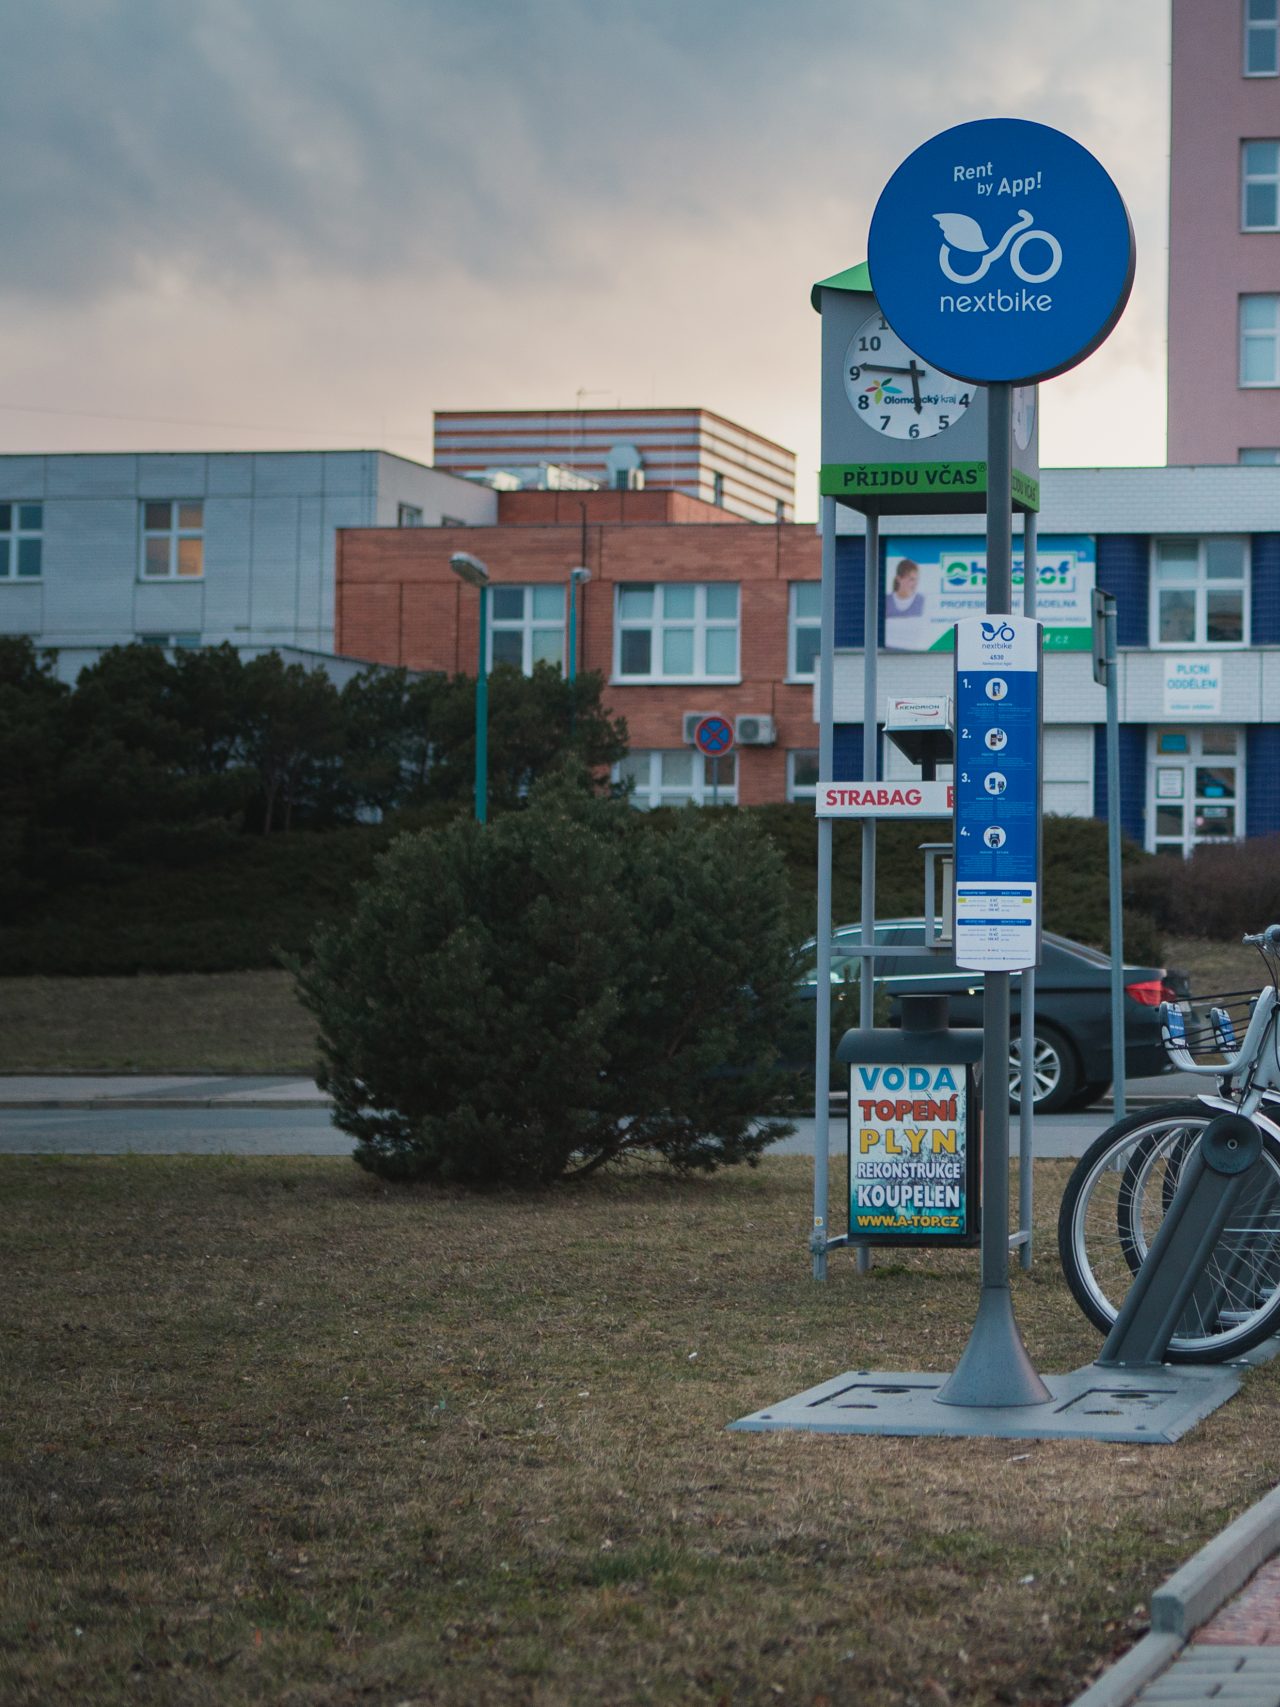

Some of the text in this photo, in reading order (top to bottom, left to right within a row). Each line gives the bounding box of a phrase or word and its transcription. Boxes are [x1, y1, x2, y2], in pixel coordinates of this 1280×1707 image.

[953, 161, 993, 182] Rent
[977, 171, 1042, 197] by App!
[940, 289, 1052, 313] nextbike
[858, 336, 881, 351] 10
[849, 366, 860, 381] 9
[858, 395, 869, 410] 8
[958, 393, 970, 408] 4
[880, 415, 891, 431] 7
[938, 415, 949, 430] 5
[908, 424, 920, 439] 6
[843, 466, 918, 487] PŘIJDU
[981, 642, 1012, 650] nextbike
[962, 678, 972, 689] 1.
[961, 728, 972, 739] 2.
[961, 772, 971, 783] 3.
[826, 789, 922, 806] STRABAG
[960, 826, 970, 837] 4.
[859, 1067, 958, 1091] VODA
[858, 1094, 959, 1122] TOPENÍ
[859, 1129, 958, 1154] PLYN
[857, 1162, 961, 1179] REKONSTRUKCE
[857, 1185, 960, 1208] KOUPELEN
[857, 1215, 960, 1228] WWW.A-TOP.CZ
